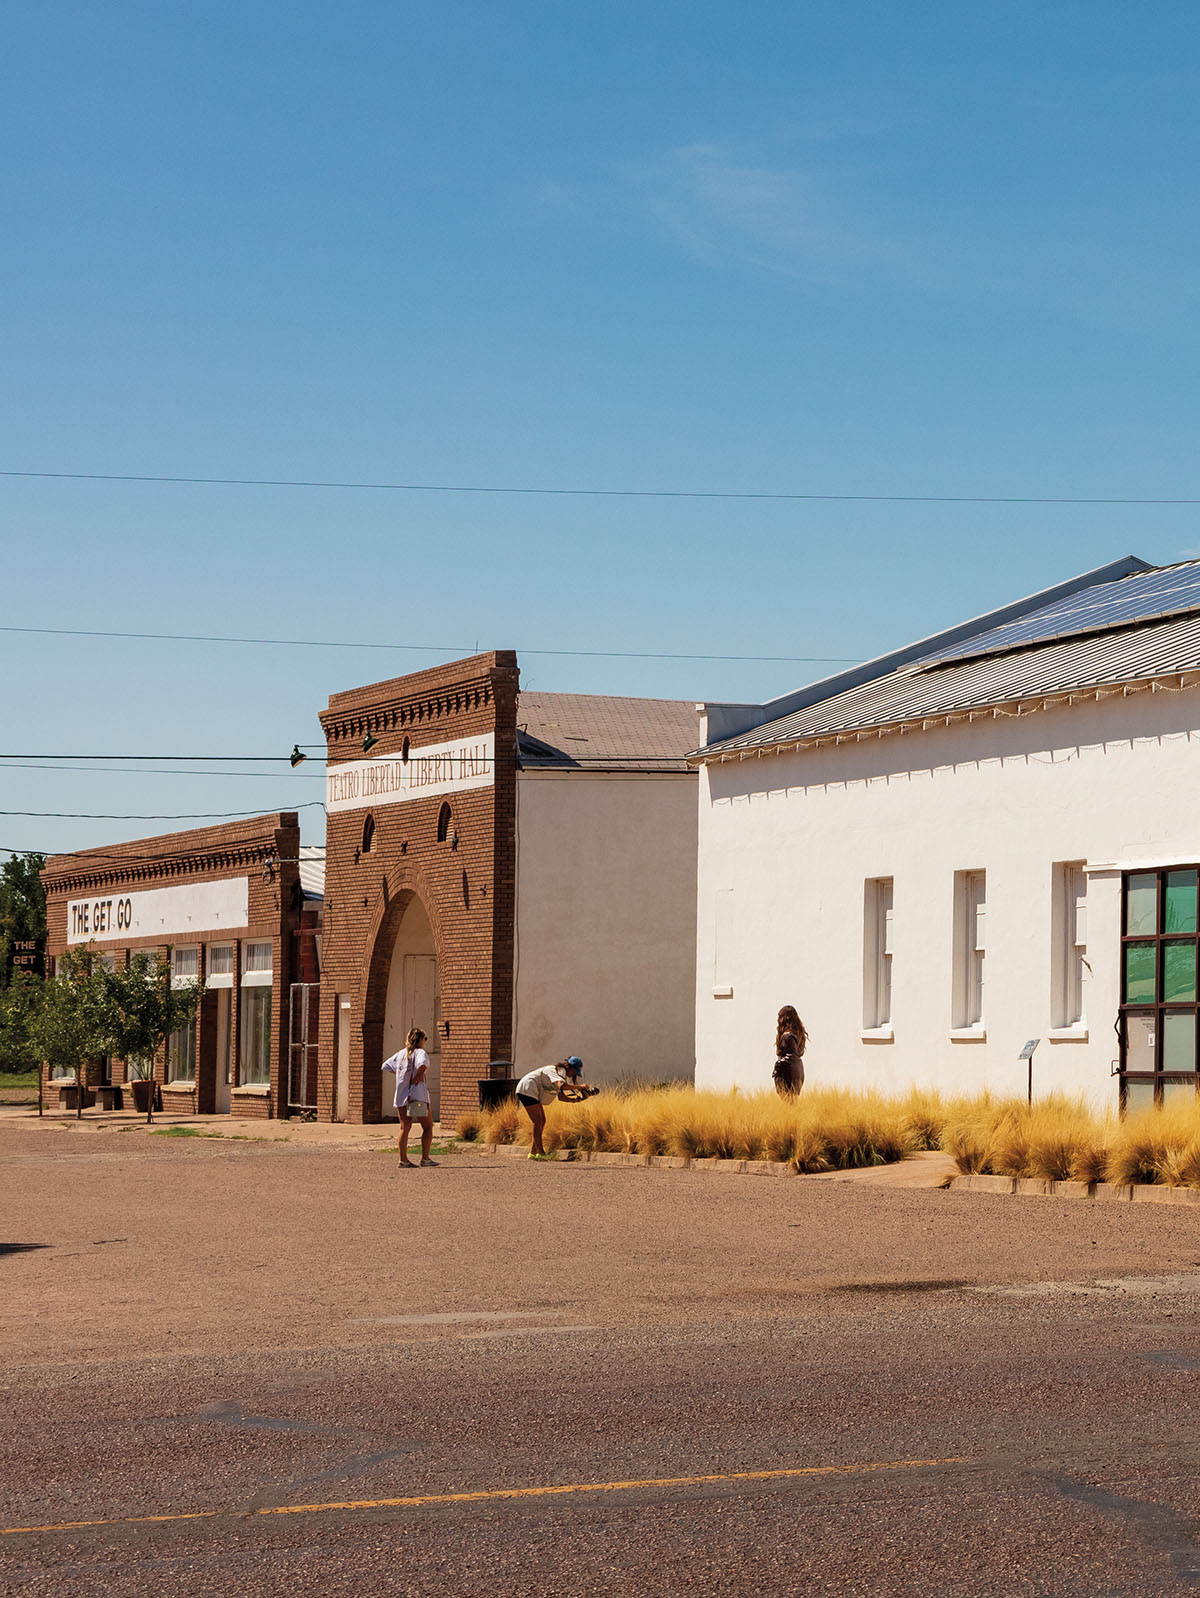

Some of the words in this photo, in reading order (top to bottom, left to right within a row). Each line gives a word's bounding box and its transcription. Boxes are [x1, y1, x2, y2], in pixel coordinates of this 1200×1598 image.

[328, 771, 359, 802] TEATRO
[361, 761, 401, 797] LIBERTAD
[408, 750, 456, 788] LIBERTY
[459, 743, 491, 780] HALL
[72, 904, 89, 936] THE
[93, 901, 112, 934] GET
[117, 897, 132, 931] GO
[14, 940, 36, 950] THE
[13, 955, 36, 965] GET
